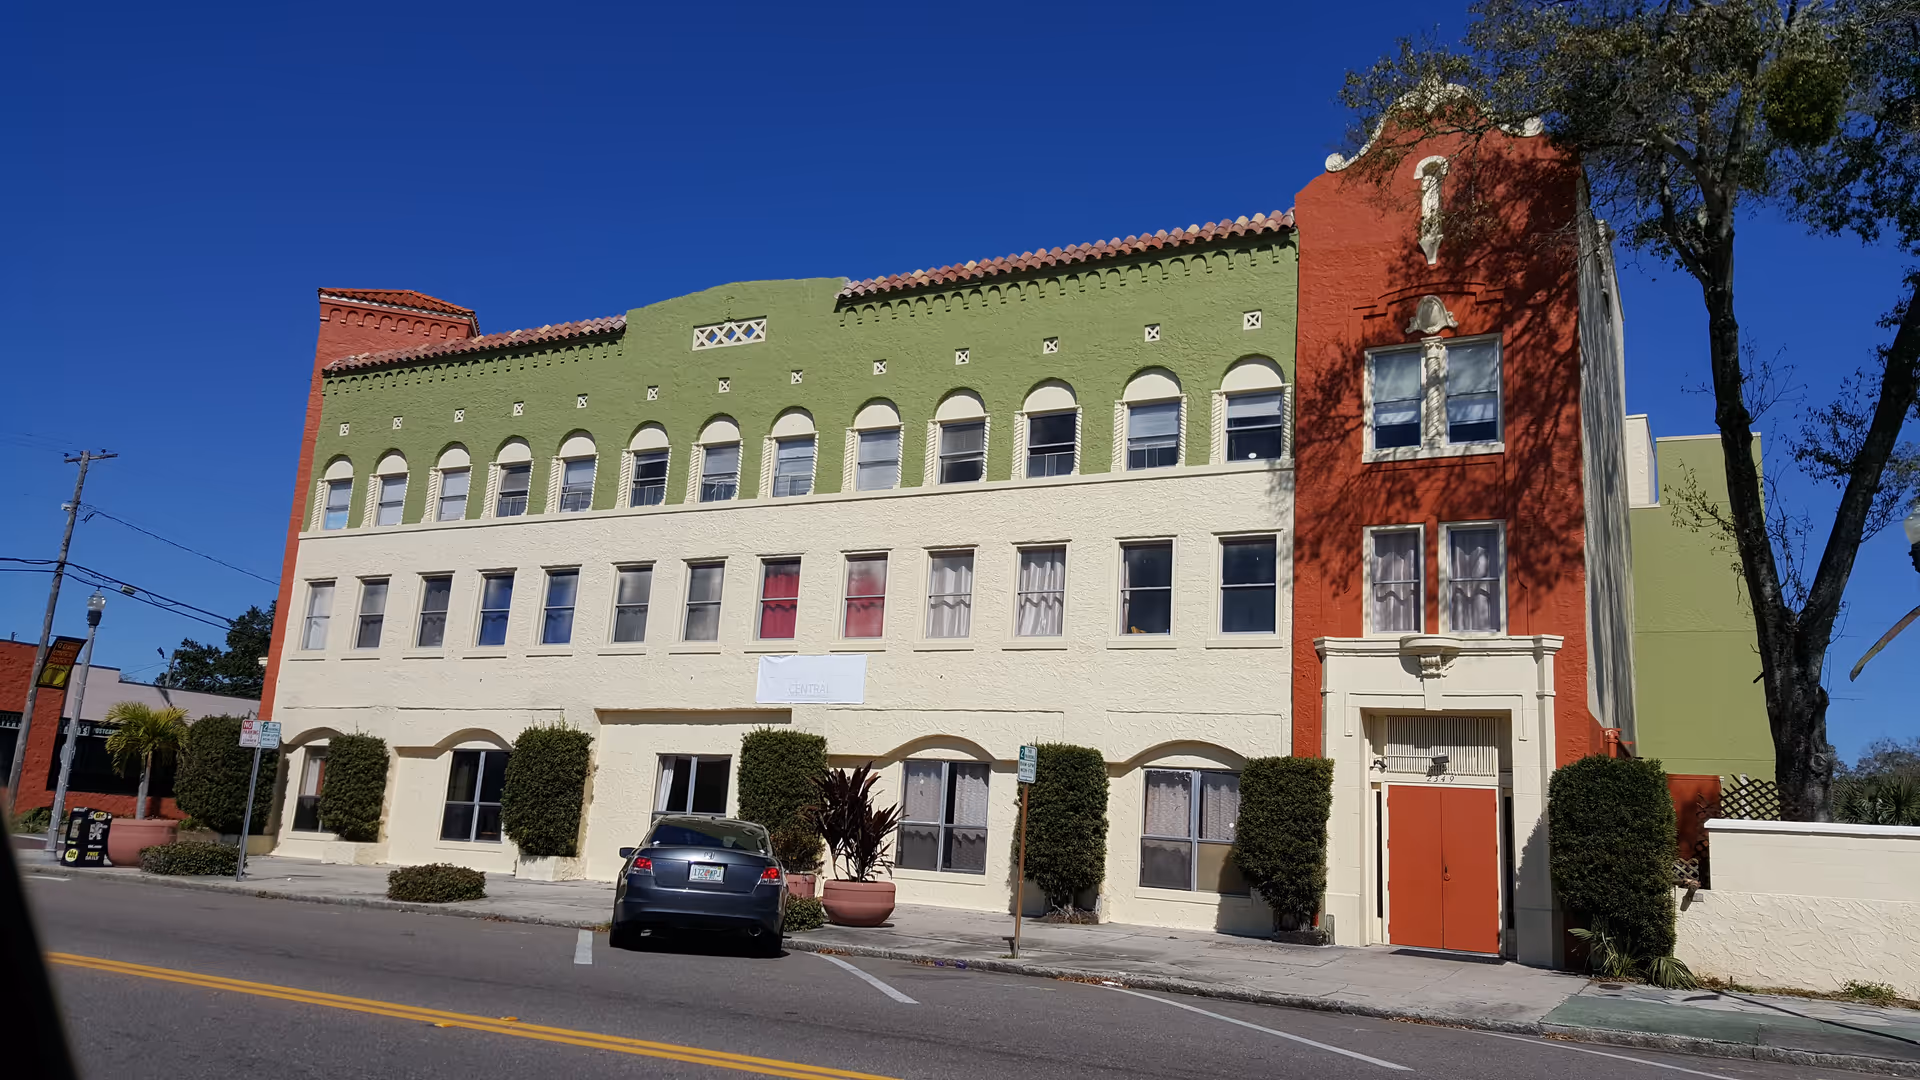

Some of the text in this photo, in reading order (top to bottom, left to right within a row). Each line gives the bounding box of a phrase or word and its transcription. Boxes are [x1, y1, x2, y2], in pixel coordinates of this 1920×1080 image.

[788, 682, 830, 694] CENTRAL
[243, 721, 253, 729] NO
[263, 722, 268, 731] 2
[1020, 748, 1025, 758] 2
[1426, 775, 1455, 784] 2349
